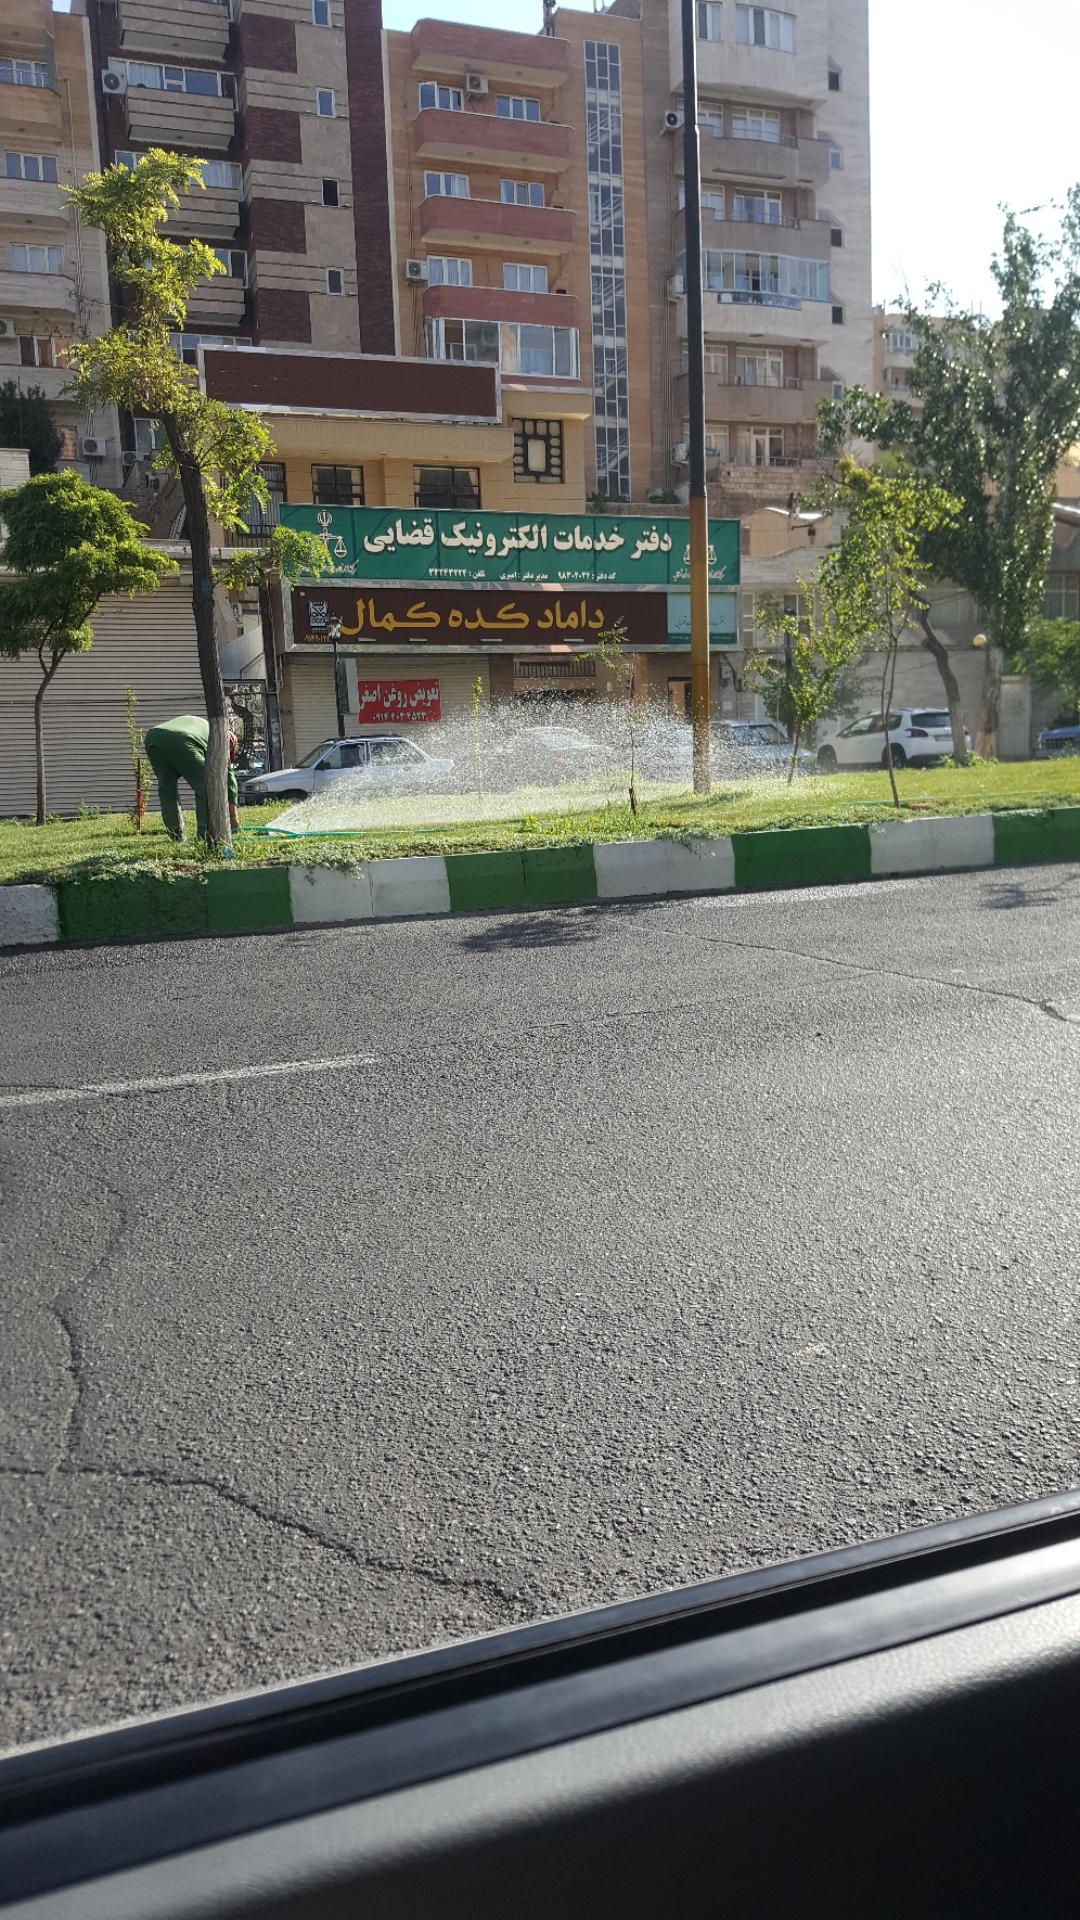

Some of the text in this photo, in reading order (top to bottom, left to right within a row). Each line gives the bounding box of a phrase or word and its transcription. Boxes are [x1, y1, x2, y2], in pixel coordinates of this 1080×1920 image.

[363, 517, 672, 559] دفتر خدمات الکترونیک قضایی
[499, 571, 517, 580] امیری
[340, 597, 605, 636] داماد کده کمال
[360, 681, 439, 710] تعویض روغن اصغر
